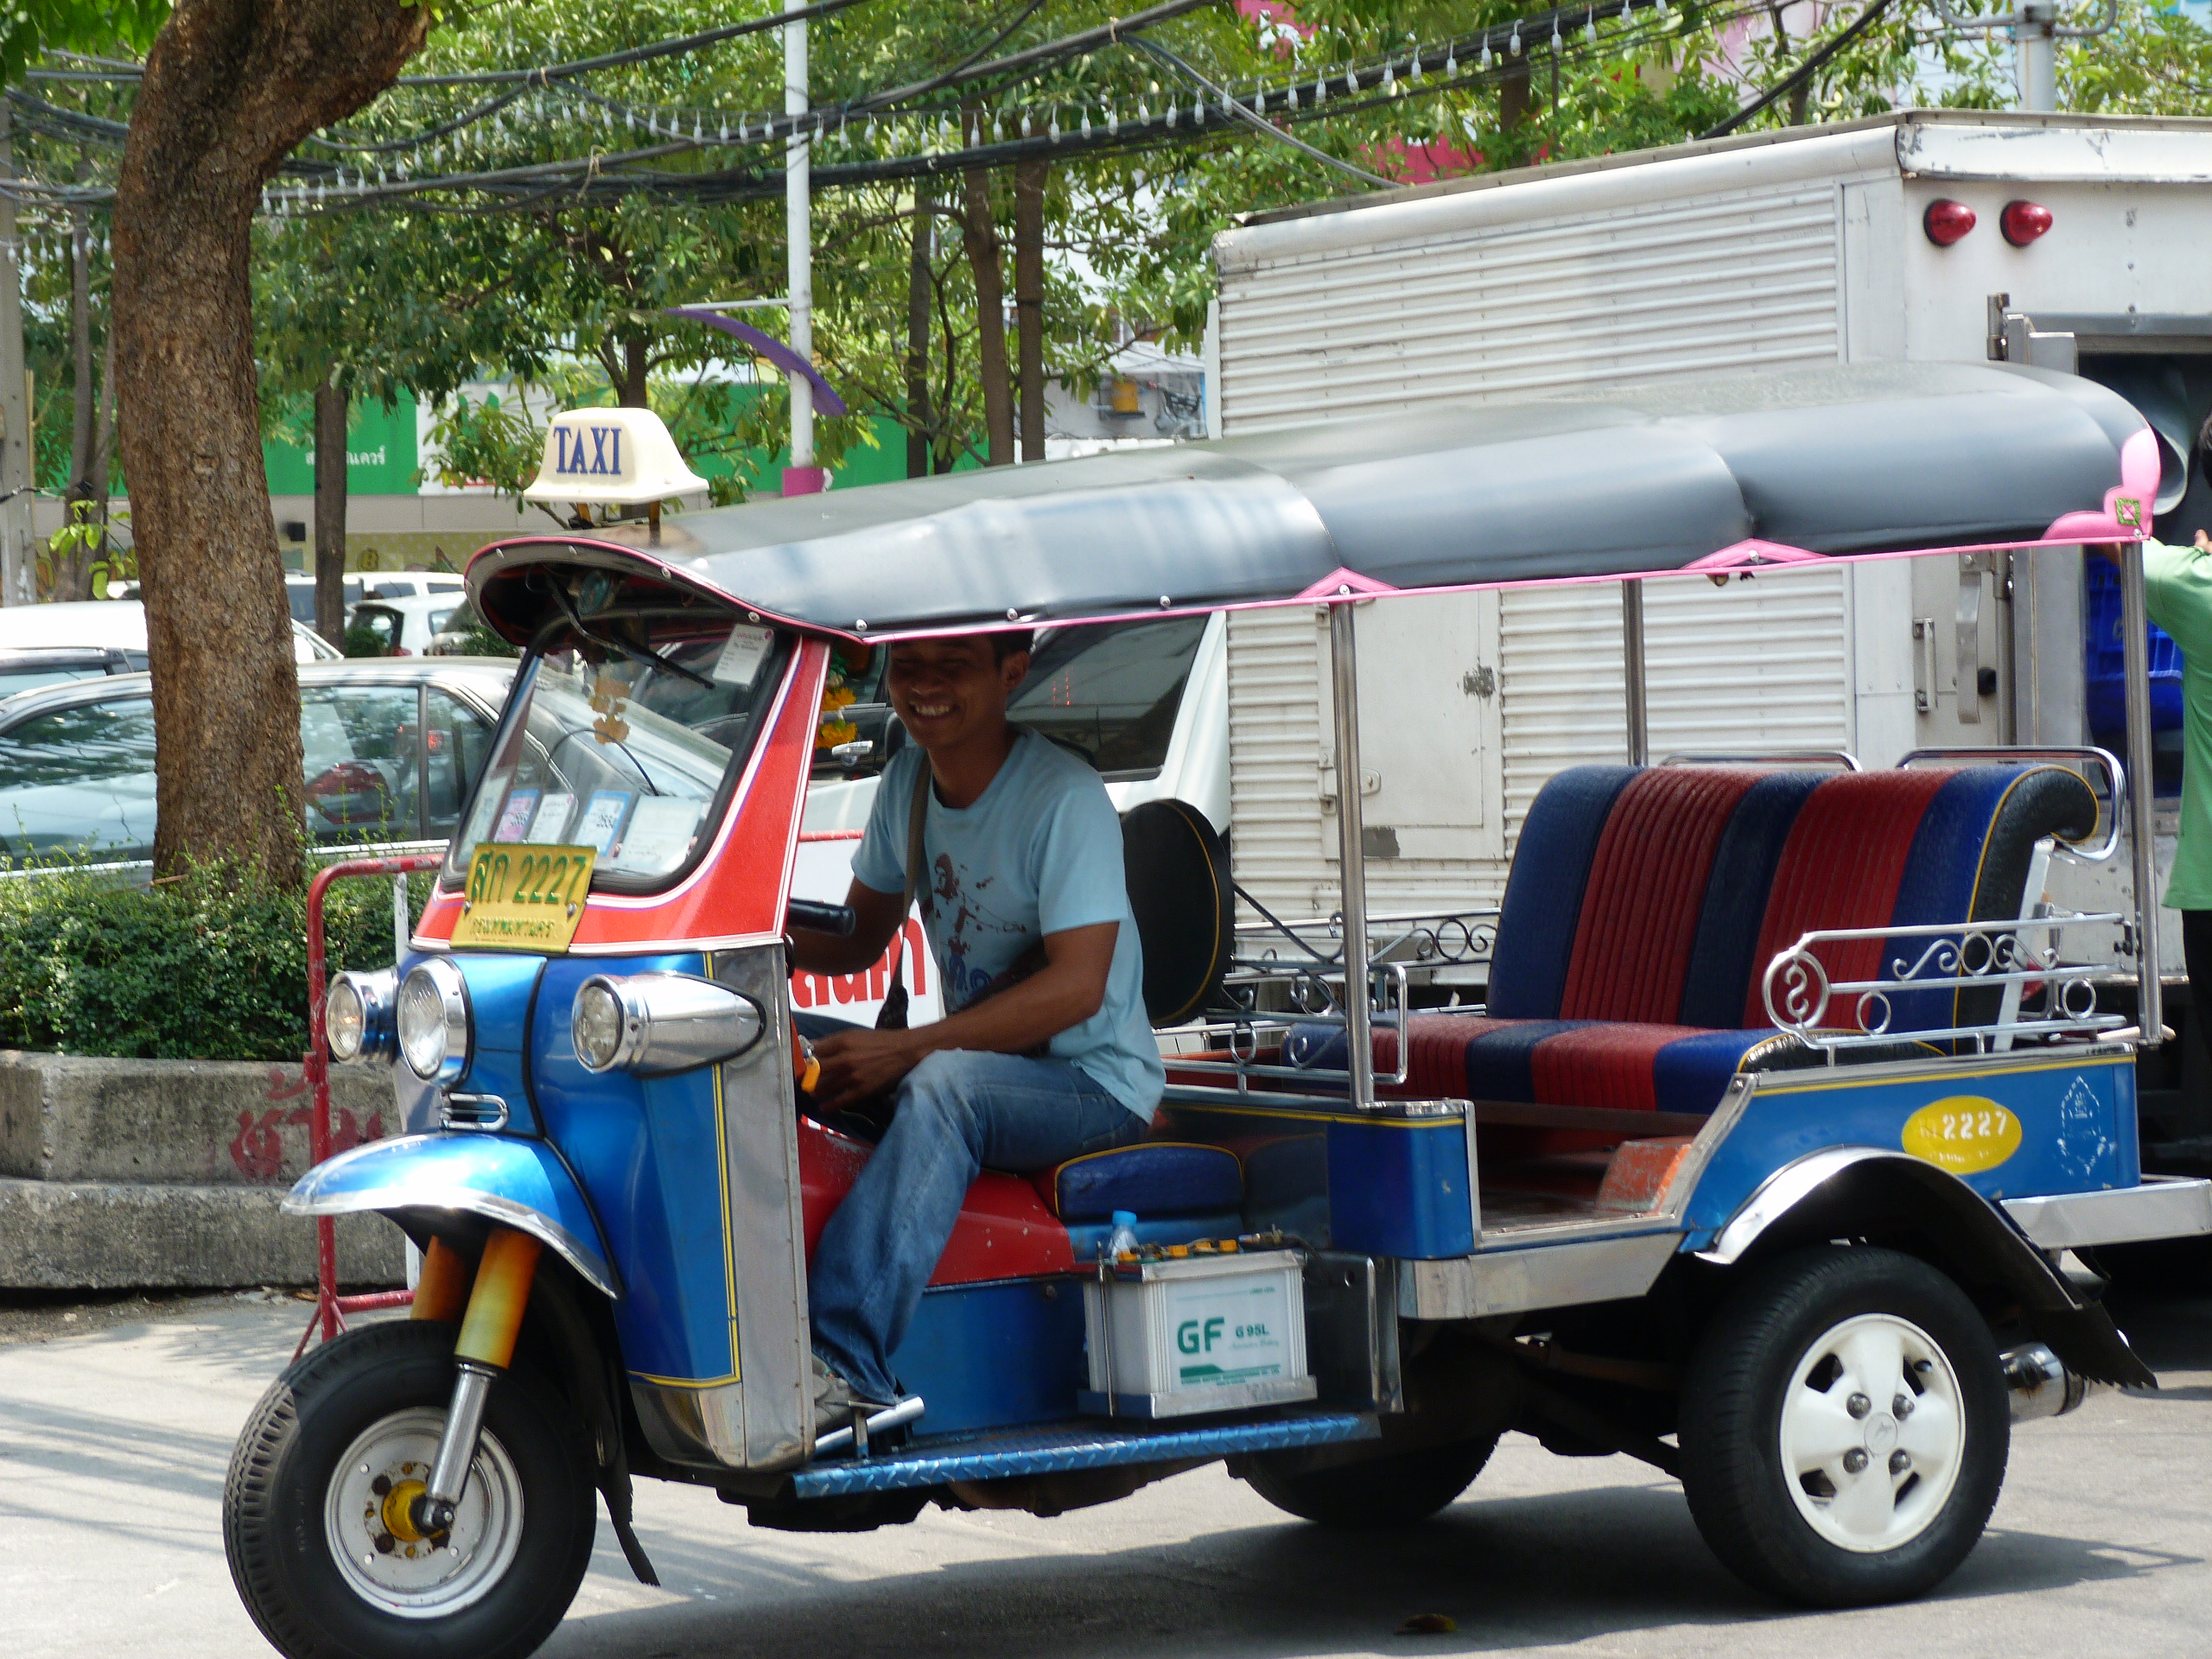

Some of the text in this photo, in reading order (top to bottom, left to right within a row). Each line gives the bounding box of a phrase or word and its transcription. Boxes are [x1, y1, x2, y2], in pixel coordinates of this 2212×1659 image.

[553, 425, 621, 475] TAXI
[512, 853, 588, 905] 2227
[1942, 1109, 2007, 1141] 2227
[1178, 1317, 1224, 1354] GF
